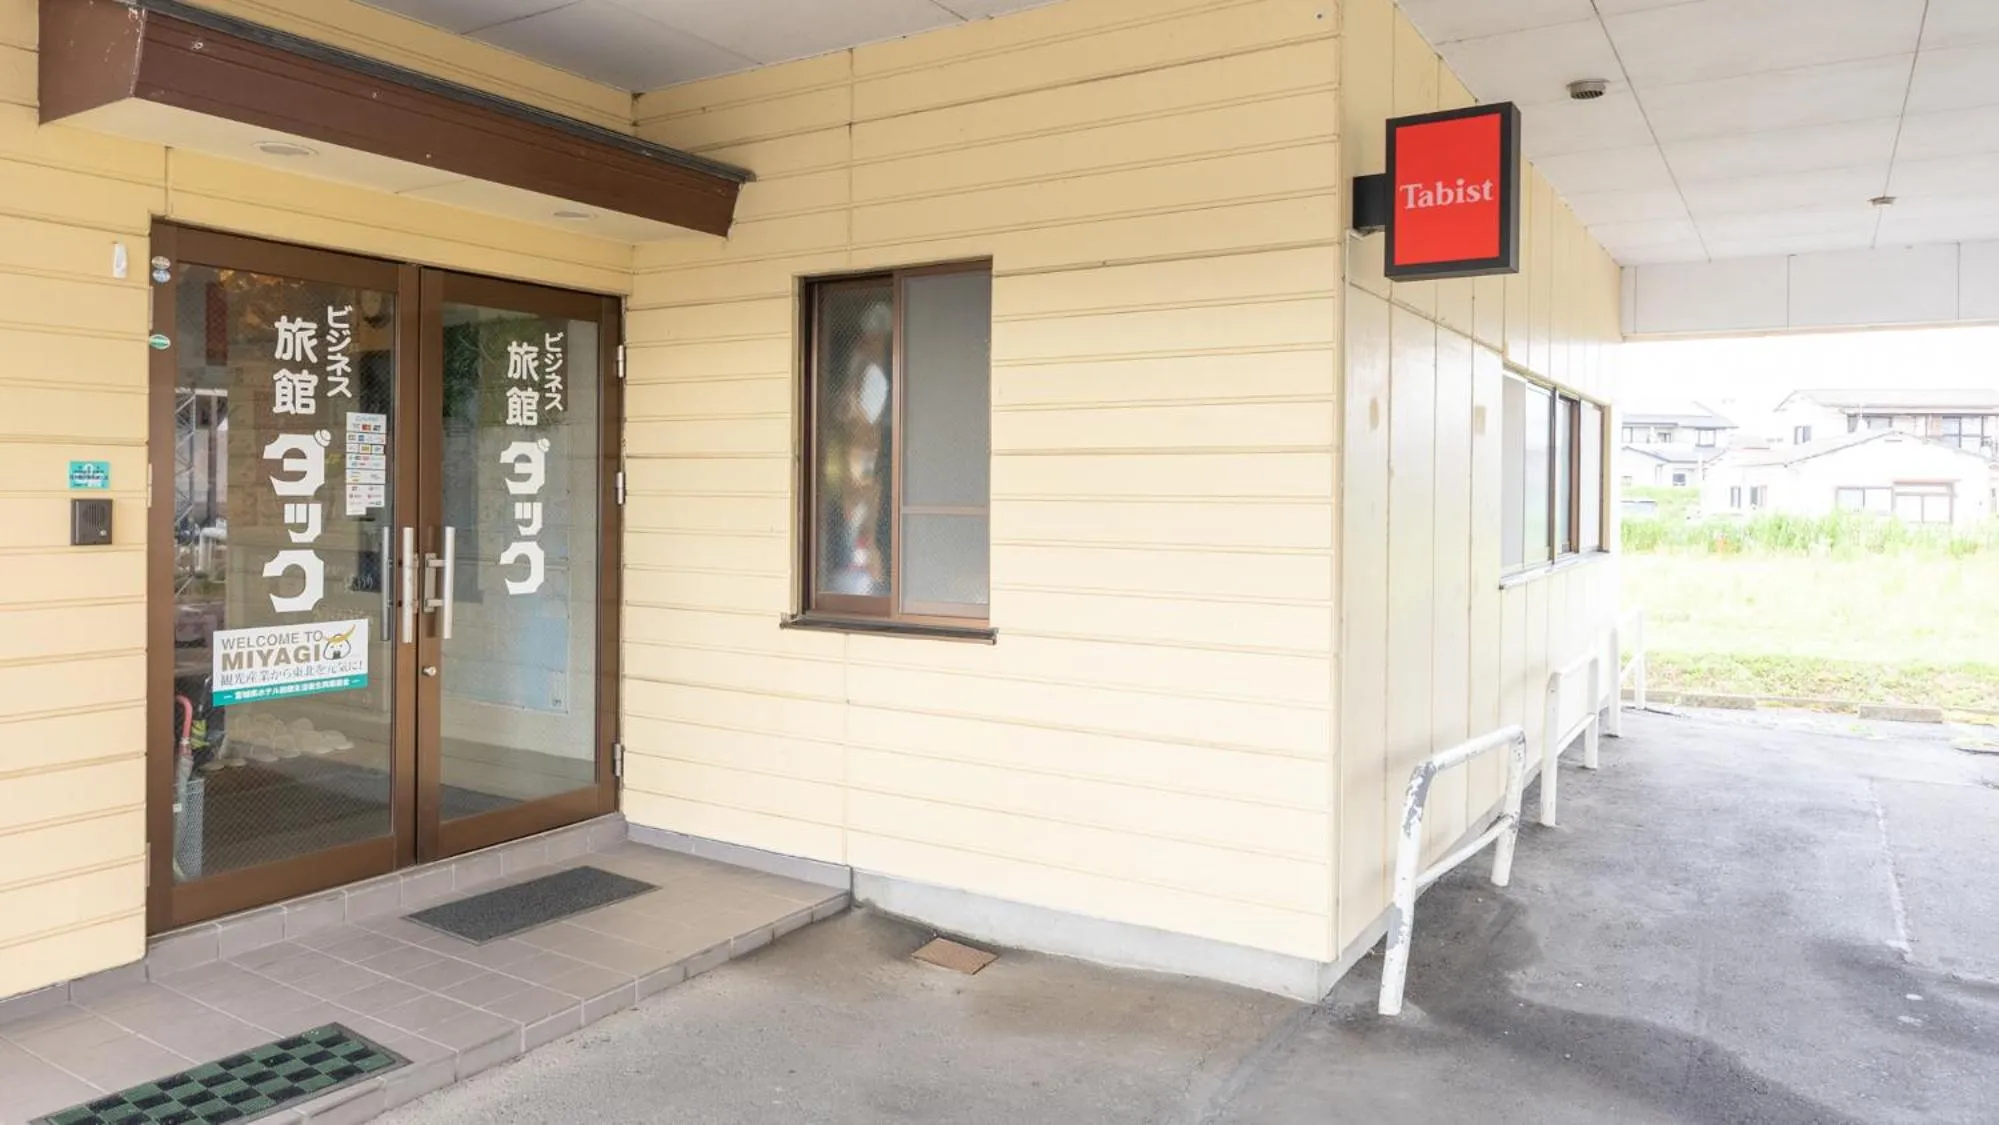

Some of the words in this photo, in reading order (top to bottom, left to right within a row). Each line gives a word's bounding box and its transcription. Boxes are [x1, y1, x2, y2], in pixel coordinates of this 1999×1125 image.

[1400, 178, 1493, 209] Tabist
[273, 315, 319, 415] 旅館
[326, 305, 353, 399] ビジネス
[506, 341, 540, 426] 旅館
[544, 332, 564, 412] ビジネス
[262, 429, 332, 613] ダック
[499, 438, 551, 596] ダック
[220, 632, 300, 651] WELCOME
[304, 630, 324, 643] TO
[221, 644, 320, 673] MIYAGI
